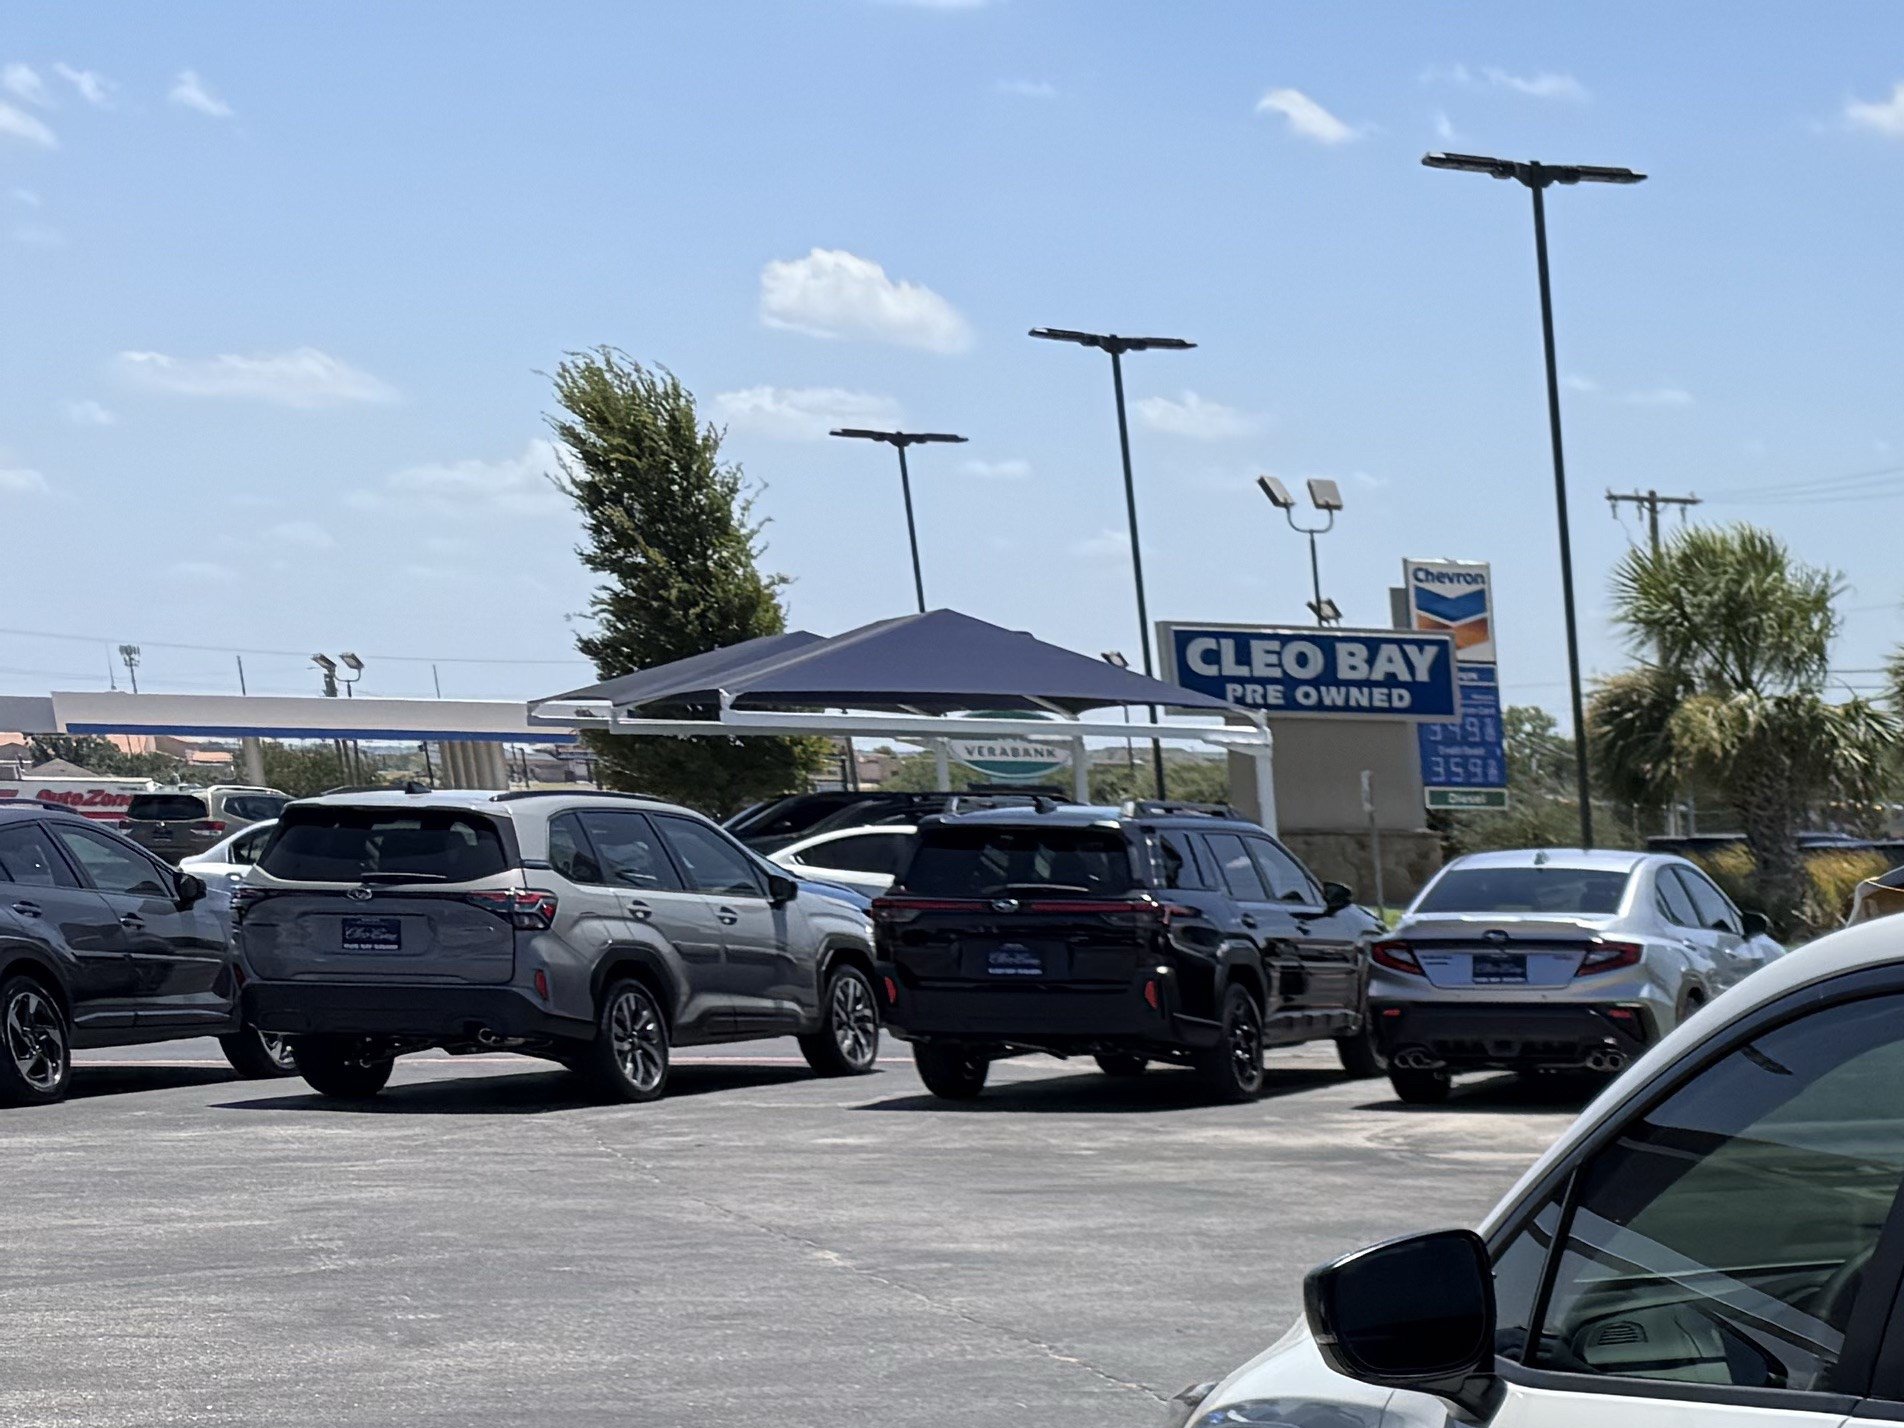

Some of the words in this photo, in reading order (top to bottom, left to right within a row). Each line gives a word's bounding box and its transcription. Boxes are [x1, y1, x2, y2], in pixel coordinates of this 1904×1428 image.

[1413, 567, 1486, 585] Chevron
[1186, 637, 1324, 681] CLEO
[1335, 642, 1440, 683] BAY
[1225, 683, 1286, 705] PRE
[1295, 687, 1411, 708] OWNED
[964, 745, 1058, 758] VERABANK
